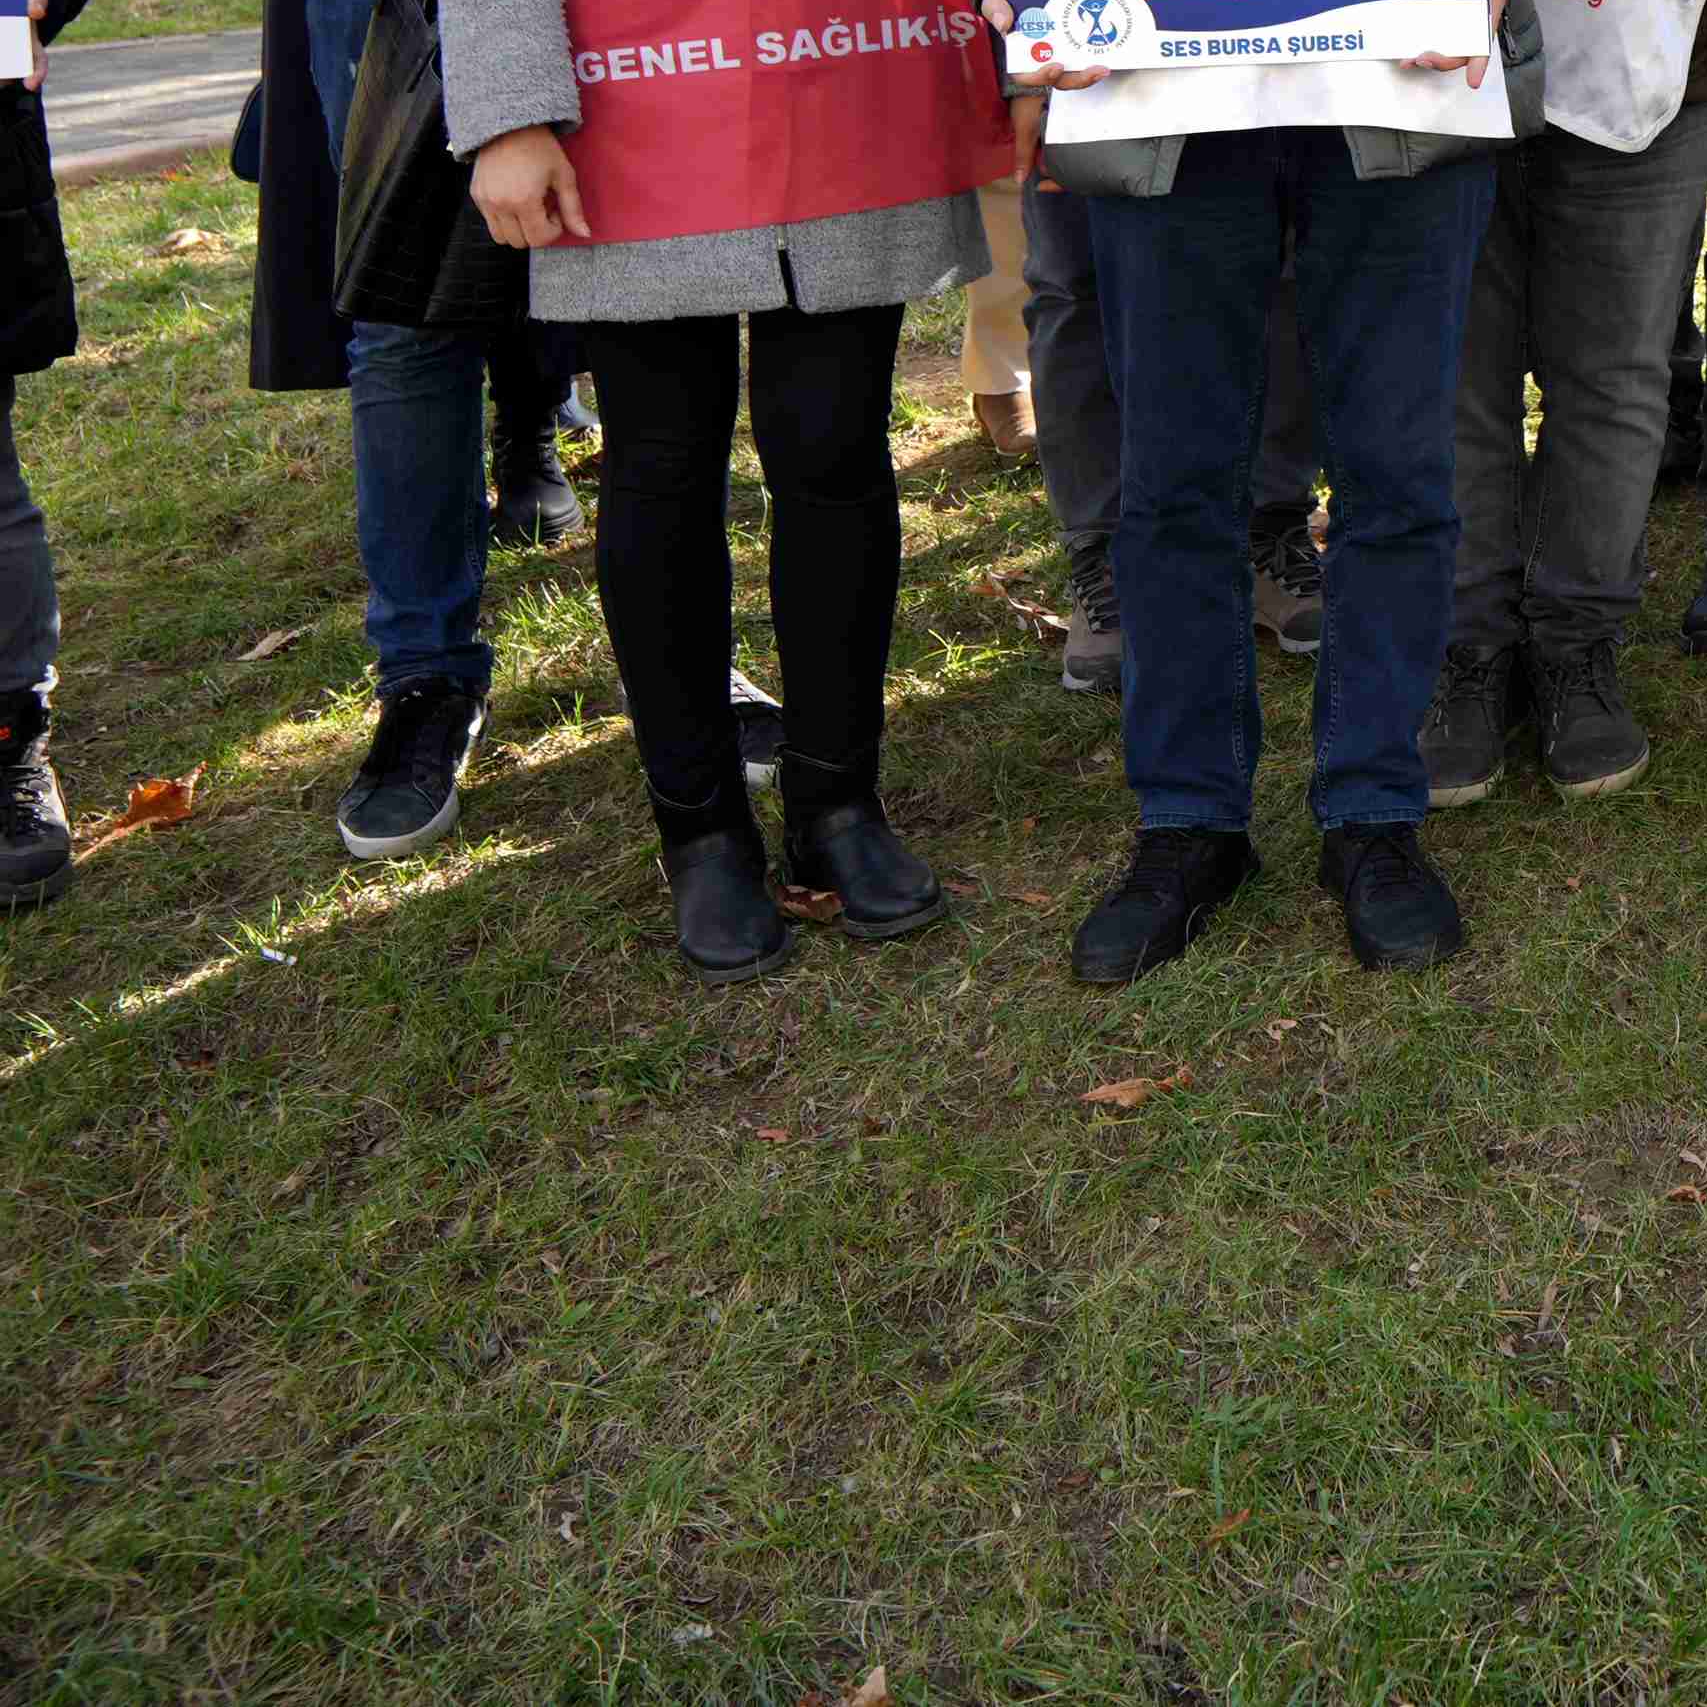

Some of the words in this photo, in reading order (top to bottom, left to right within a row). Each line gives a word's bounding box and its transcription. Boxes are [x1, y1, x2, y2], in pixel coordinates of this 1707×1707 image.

[575, 36, 741, 85] GENEL
[1160, 40, 1202, 57] SES
[1206, 37, 1282, 56] BURSA
[1288, 32, 1363, 55] ŞUBESİ
